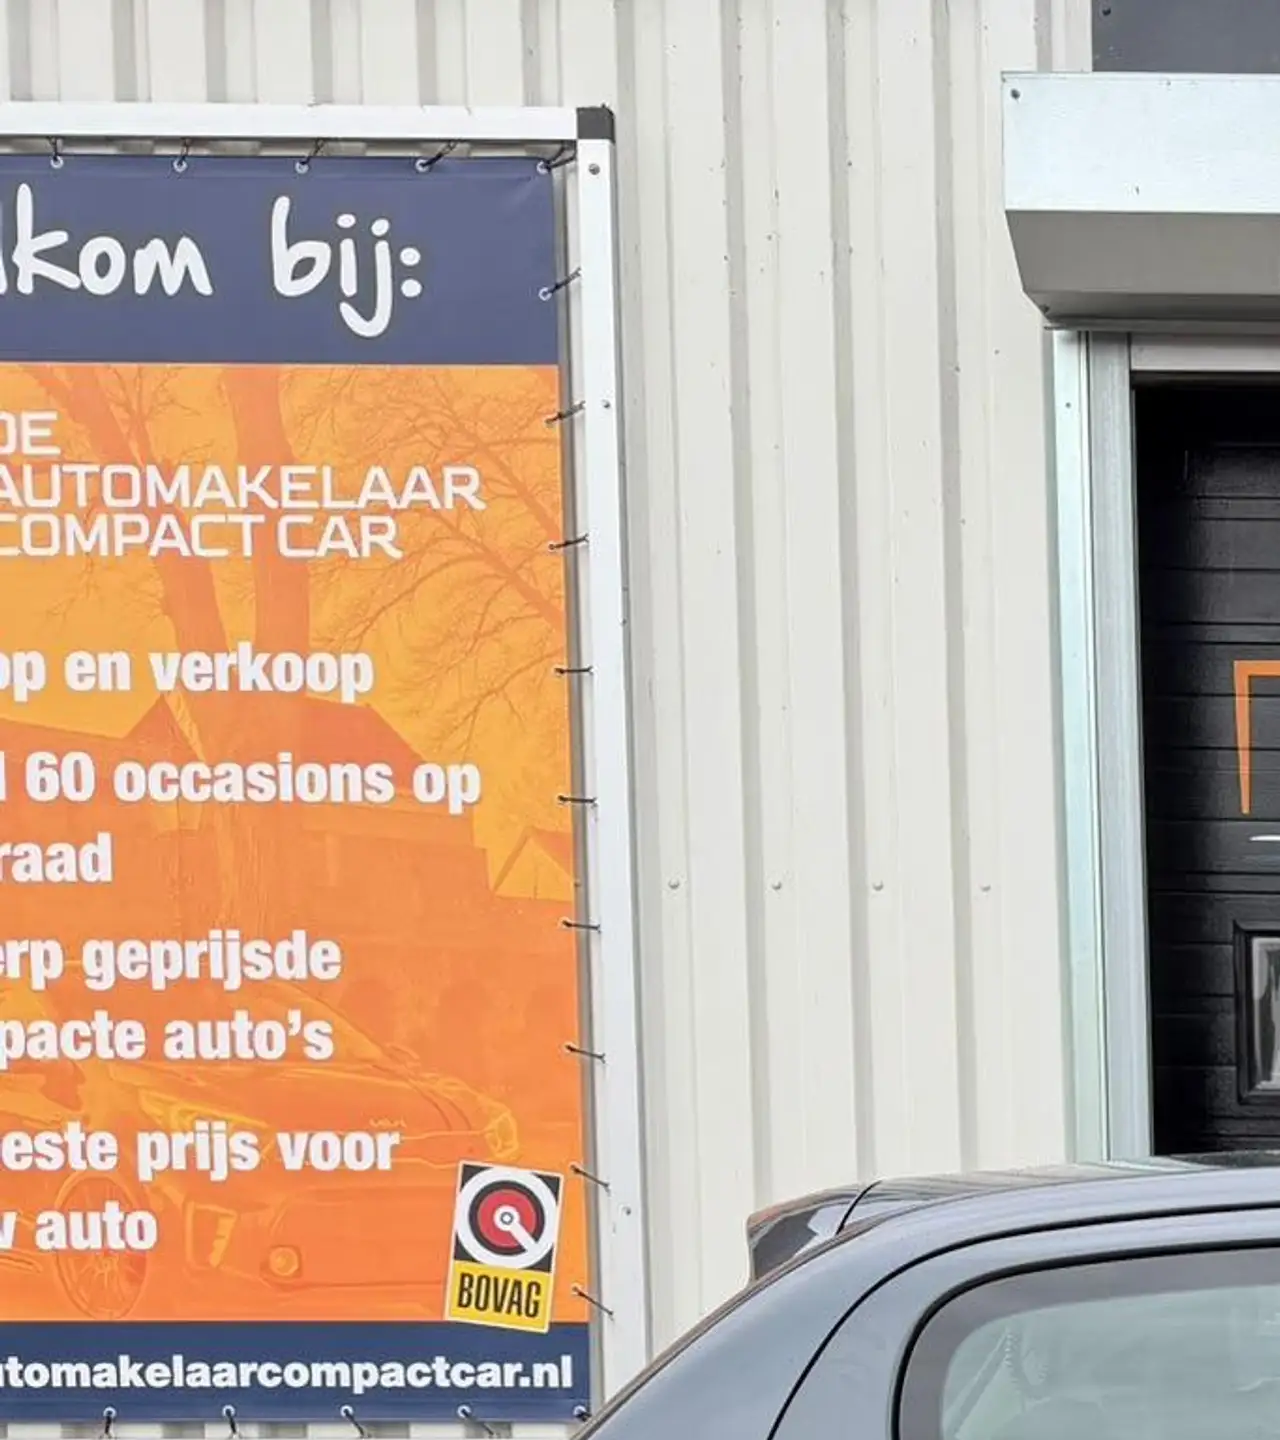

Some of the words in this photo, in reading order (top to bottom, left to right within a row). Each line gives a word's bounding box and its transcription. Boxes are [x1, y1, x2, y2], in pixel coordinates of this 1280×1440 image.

[272, 196, 423, 337] bij:
[0, 464, 486, 510] AUTOMAKELAAR
[277, 513, 402, 559] CAR
[65, 650, 131, 691] en
[151, 642, 373, 703] verkoop
[25, 751, 95, 801] 60
[114, 753, 395, 803] occasions
[413, 763, 481, 814] op
[0, 939, 63, 991] rp
[82, 930, 342, 990] geprijsde
[1, 1121, 118, 1171] este
[137, 1121, 261, 1182] prijs
[277, 1130, 401, 1172] voor
[35, 1201, 158, 1250] auto
[456, 1271, 542, 1319] BOVAG
[0, 1355, 572, 1395] tomakelaarcompactcar.nl
